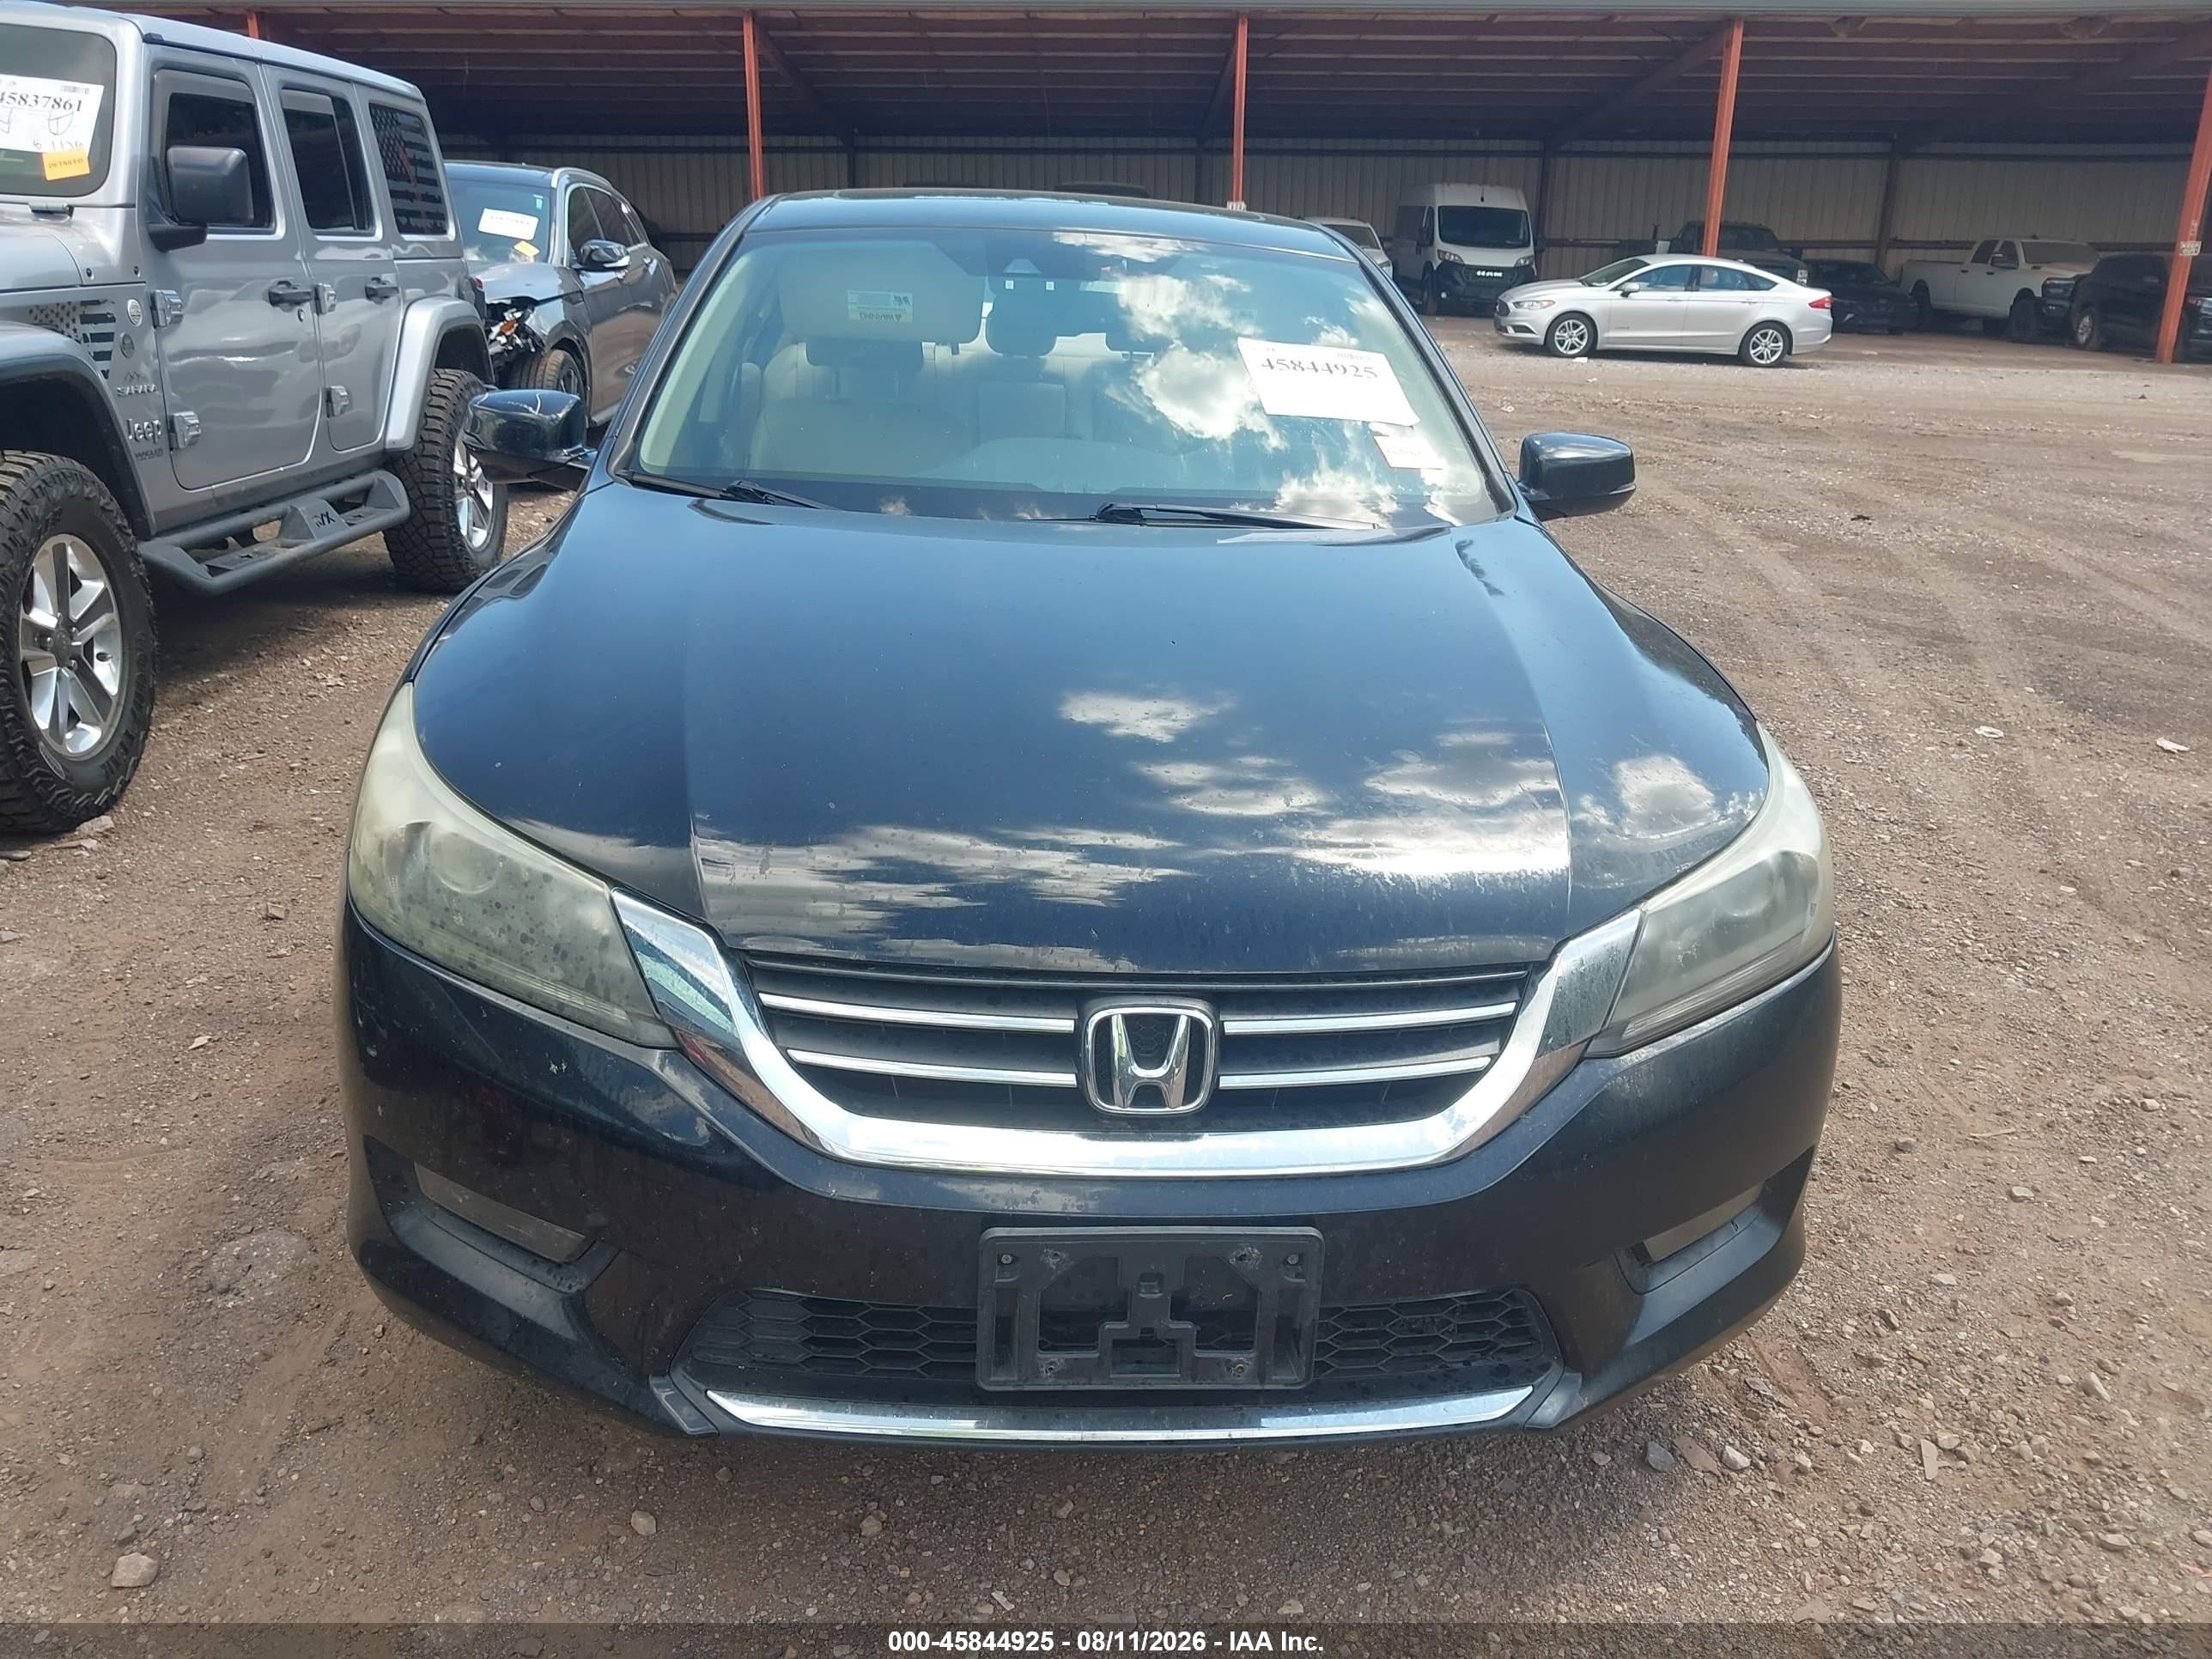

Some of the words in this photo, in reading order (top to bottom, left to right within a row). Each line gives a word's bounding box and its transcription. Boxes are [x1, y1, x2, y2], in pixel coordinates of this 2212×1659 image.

[1261, 357, 1377, 379] 45844925
[117, 384, 158, 397] SAHARA
[127, 418, 162, 444] Jeep
